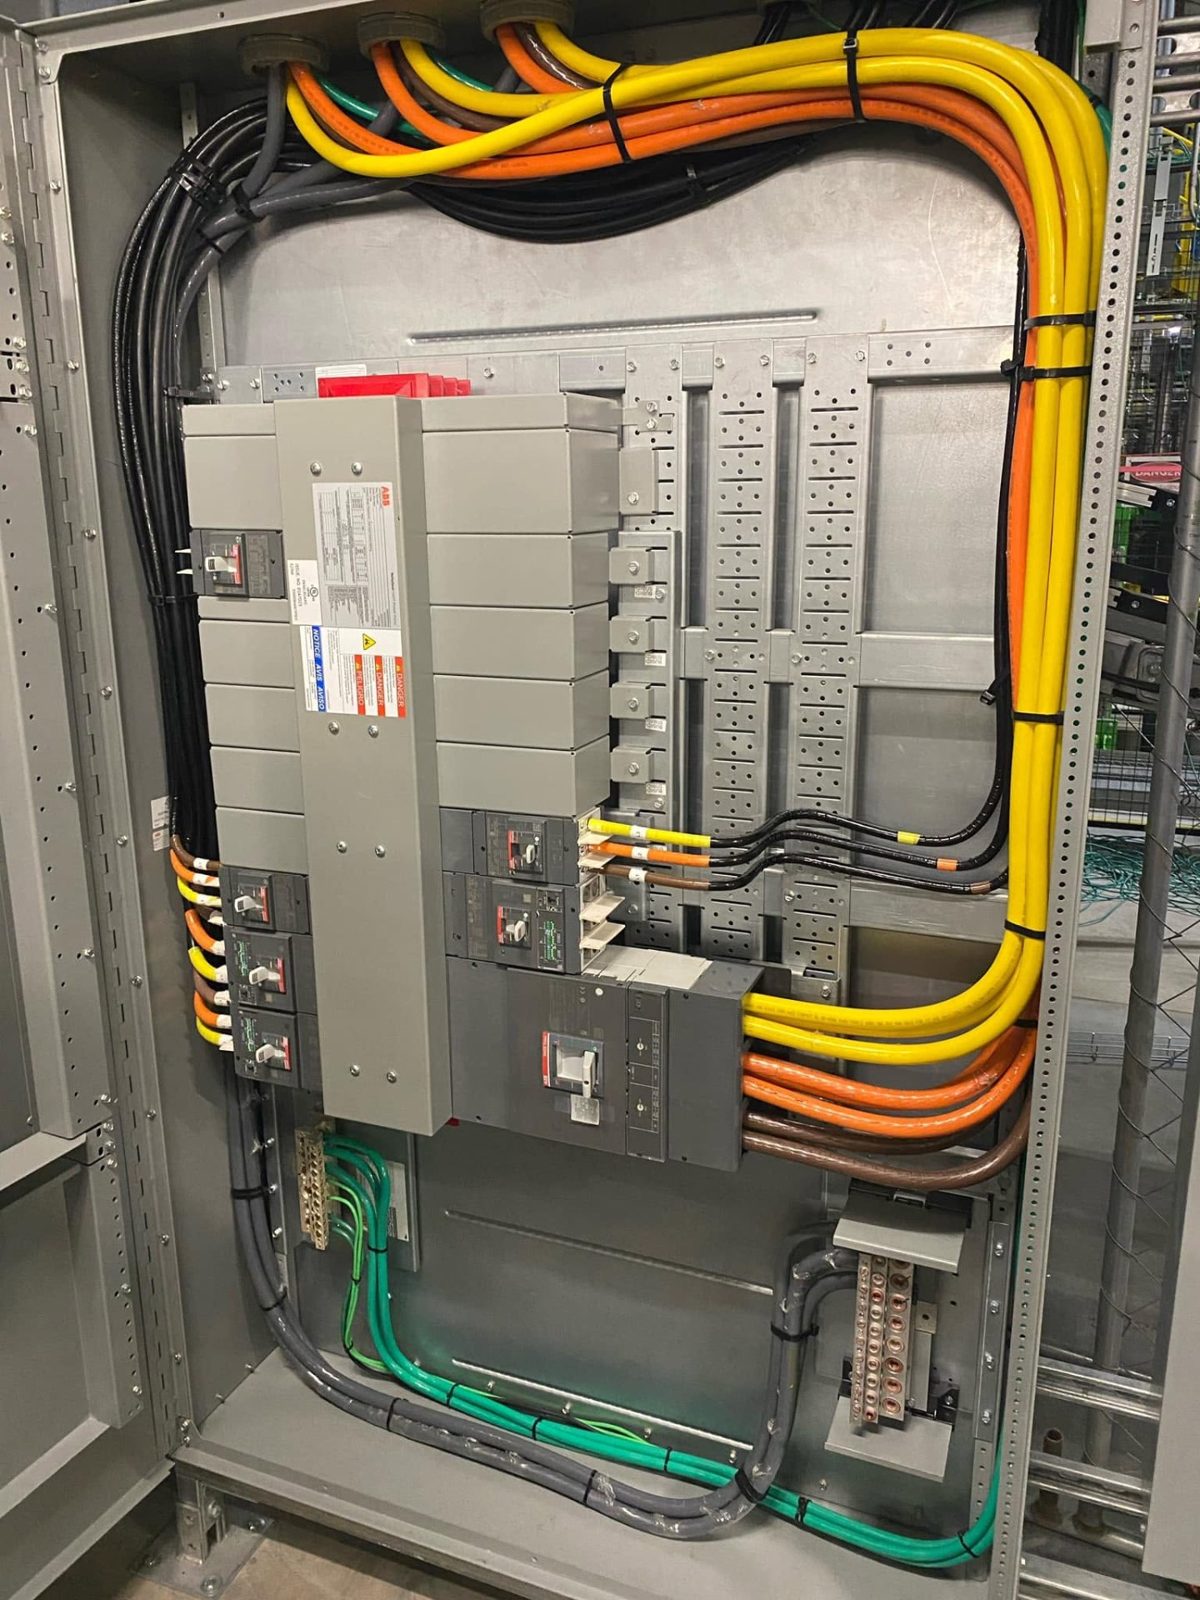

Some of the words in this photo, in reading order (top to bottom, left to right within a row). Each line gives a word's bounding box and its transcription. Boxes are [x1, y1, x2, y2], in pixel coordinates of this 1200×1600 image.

[381, 486, 390, 506] ABB
[313, 629, 321, 658] NOTICE
[315, 664, 323, 681] AVIS
[396, 673, 404, 707] DANGER
